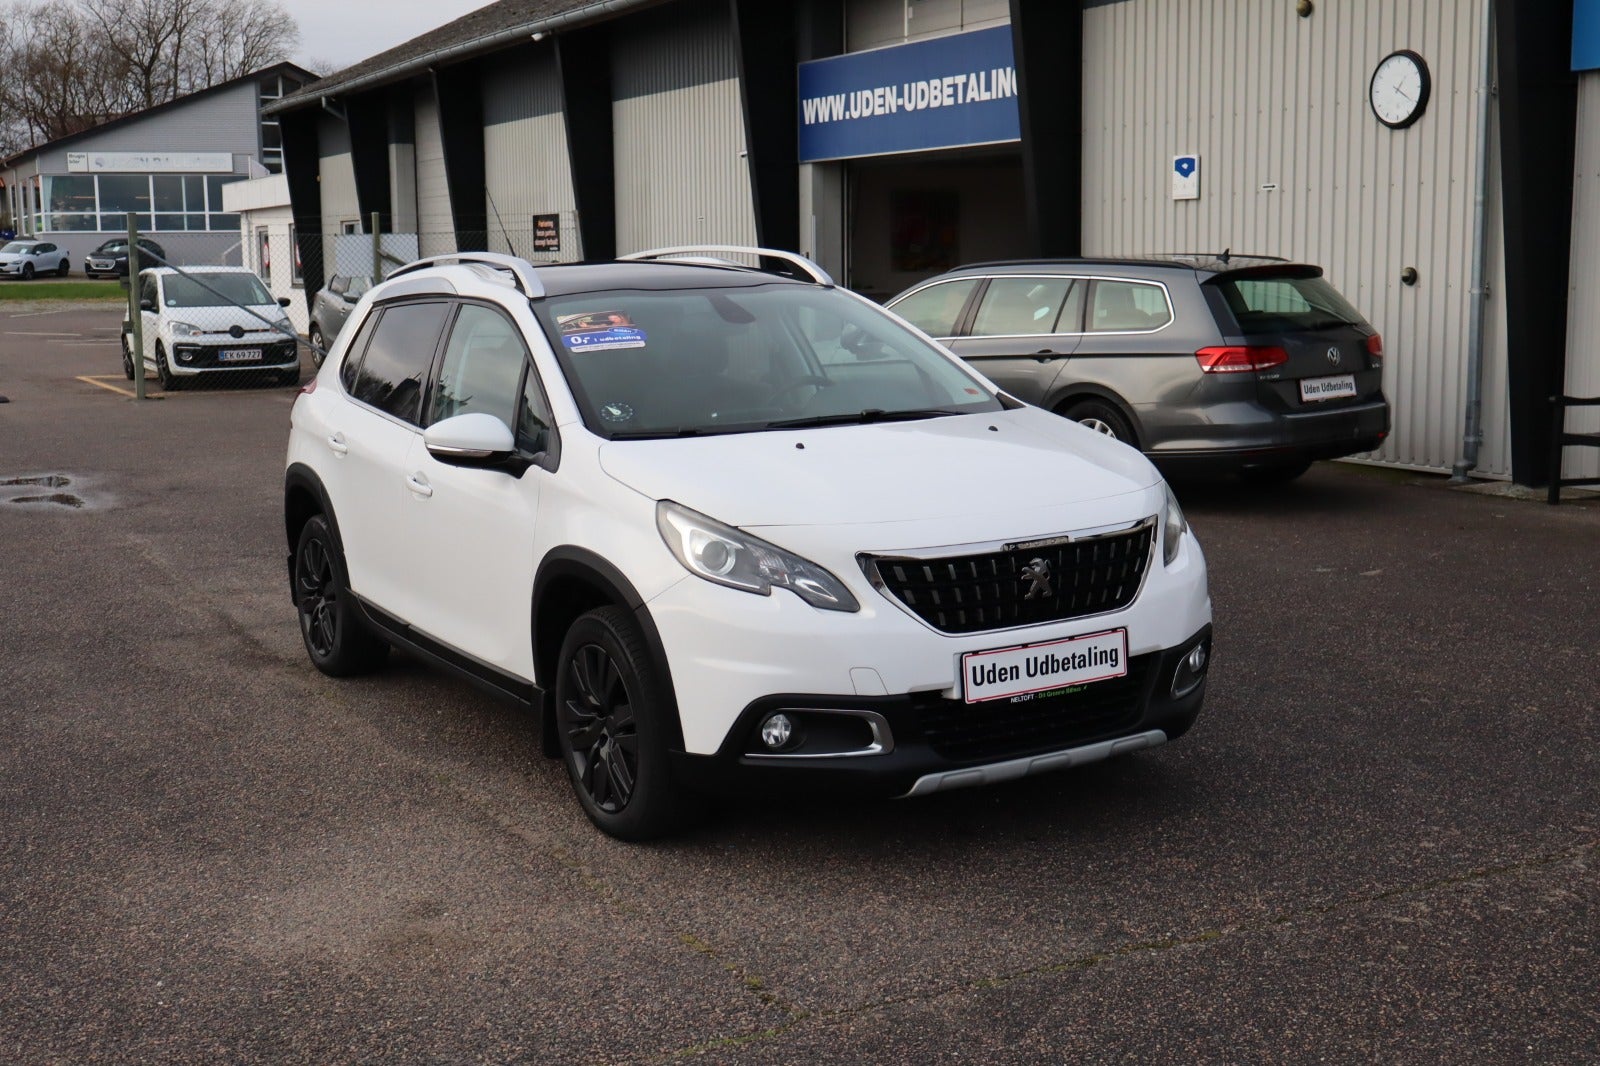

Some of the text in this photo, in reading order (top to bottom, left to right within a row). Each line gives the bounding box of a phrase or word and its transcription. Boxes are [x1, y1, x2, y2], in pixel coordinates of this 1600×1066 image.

[1303, 380, 1354, 394] Uden Udbetaling
[972, 646, 1119, 687] Uden Udbetaling
[1010, 693, 1035, 704] NELTOFT
